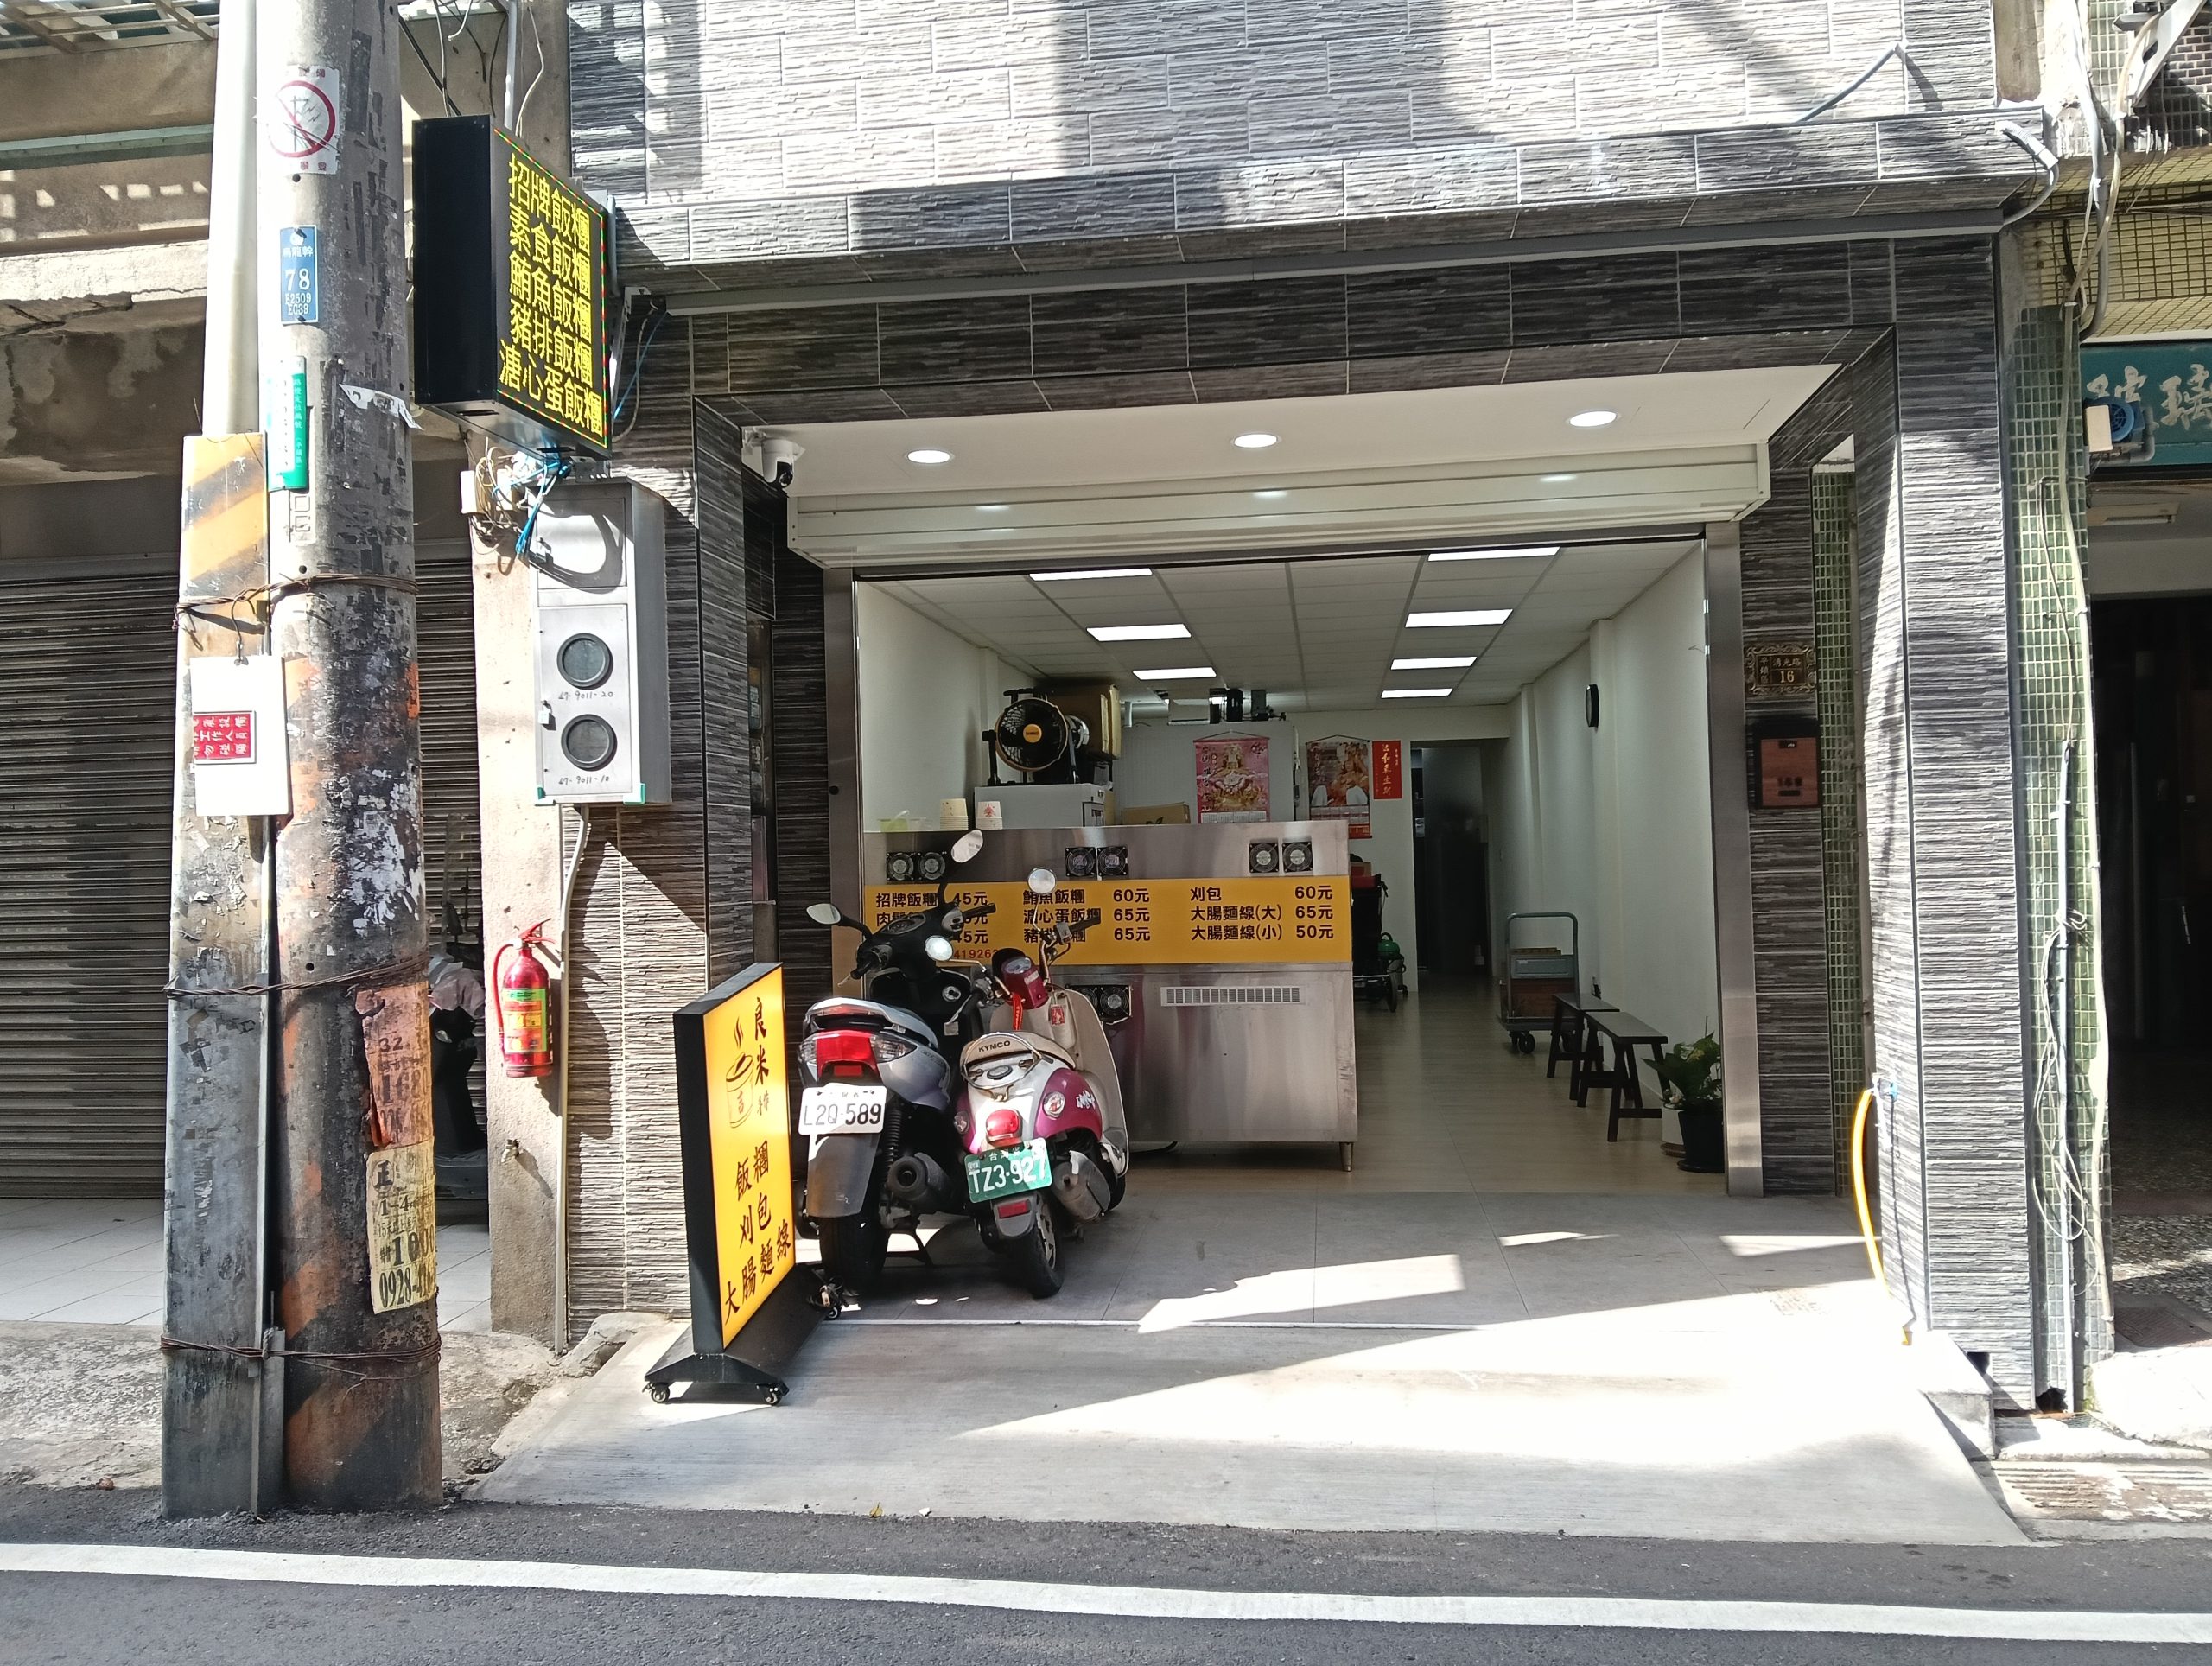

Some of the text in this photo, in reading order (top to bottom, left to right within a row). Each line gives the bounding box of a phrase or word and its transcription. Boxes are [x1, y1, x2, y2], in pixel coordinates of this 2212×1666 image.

[508, 152, 591, 256] 招牌飯糰
[509, 204, 591, 300] 素食飯糰
[284, 268, 310, 291] 78
[285, 293, 312, 304] B2509
[509, 251, 592, 344] 鮪魚飯糰
[510, 299, 593, 388] 豬排飯糰
[499, 339, 603, 437] 溏心蛋飯糰
[1780, 670, 1795, 684] 16
[876, 892, 938, 907] 招牌飯糰
[1113, 888, 1150, 903] 60元
[1190, 885, 1333, 901] 刈包 60元
[1113, 907, 1150, 922] 65元
[1190, 904, 1333, 921] 大腸麵線(大) 65元
[1114, 926, 1151, 941] 65元
[1191, 924, 1334, 941] 大腸麵線(小) 50元
[754, 995, 770, 1086] 良米
[978, 1040, 1011, 1052] KYMCO
[734, 1140, 769, 1201] 飯糰
[969, 1153, 1047, 1194] TZ3-927
[739, 1192, 772, 1249] 刈包
[724, 1218, 791, 1326] 大腸麵線
